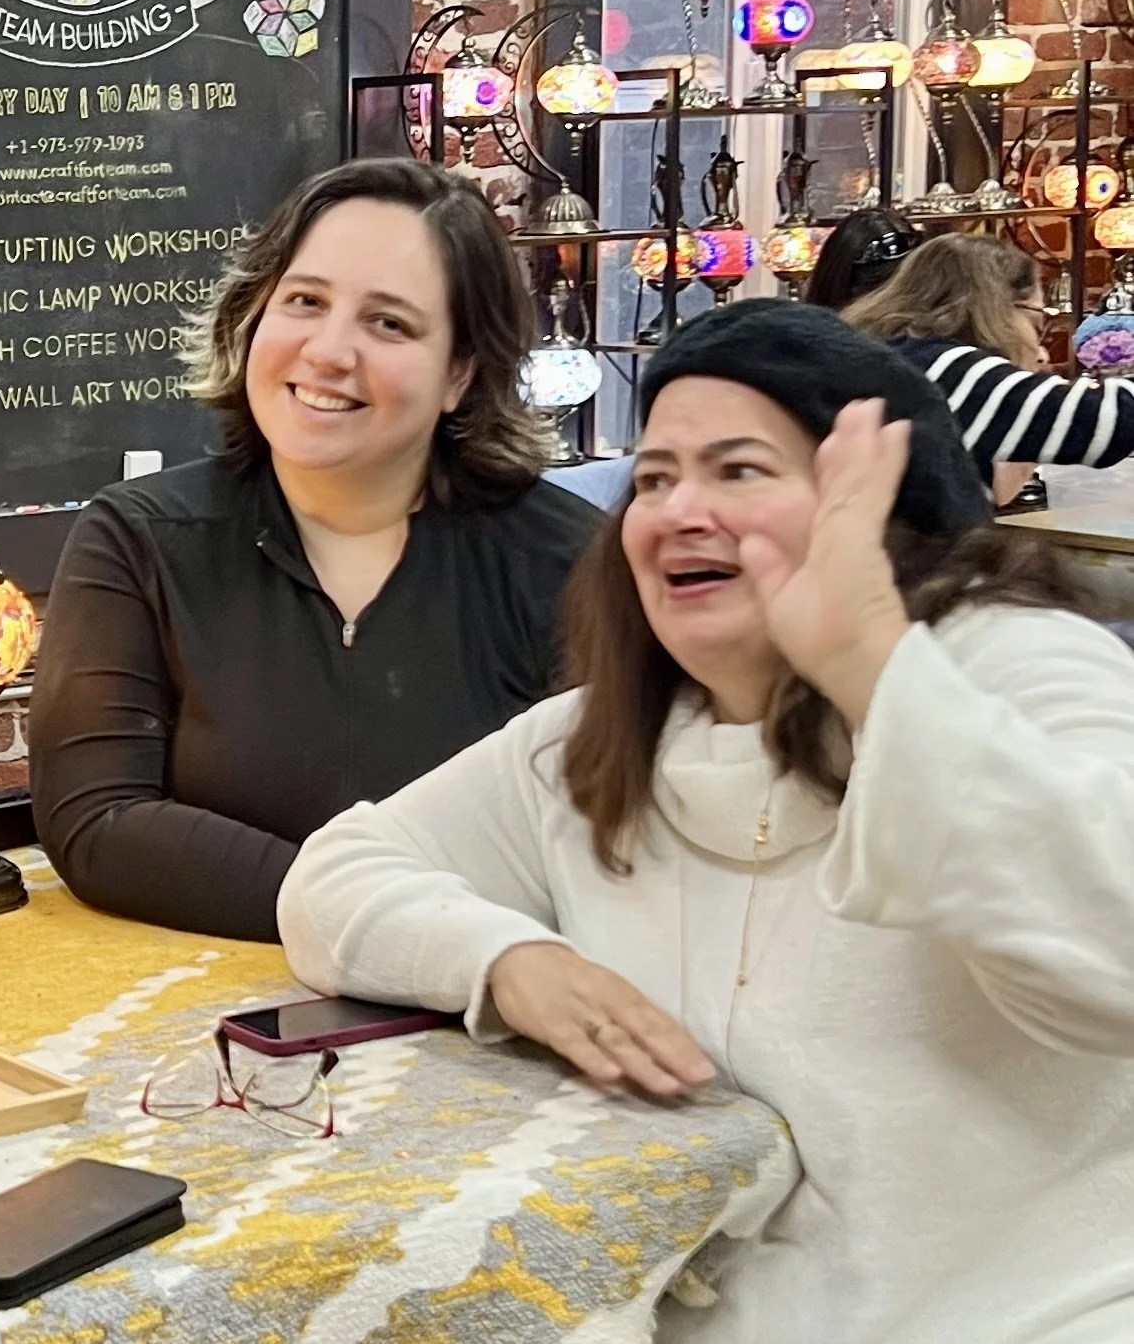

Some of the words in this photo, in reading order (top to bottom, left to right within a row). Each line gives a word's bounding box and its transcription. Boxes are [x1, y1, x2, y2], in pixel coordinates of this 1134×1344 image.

[61, 4, 172, 50] BUILDING
[24, 87, 69, 114] DAY
[97, 85, 122, 113] 10
[126, 83, 161, 113] AM
[205, 82, 236, 111] PM
[39, 285, 102, 312] LAMP
[23, 332, 117, 358] COFFEE
[71, 381, 114, 407] ART
